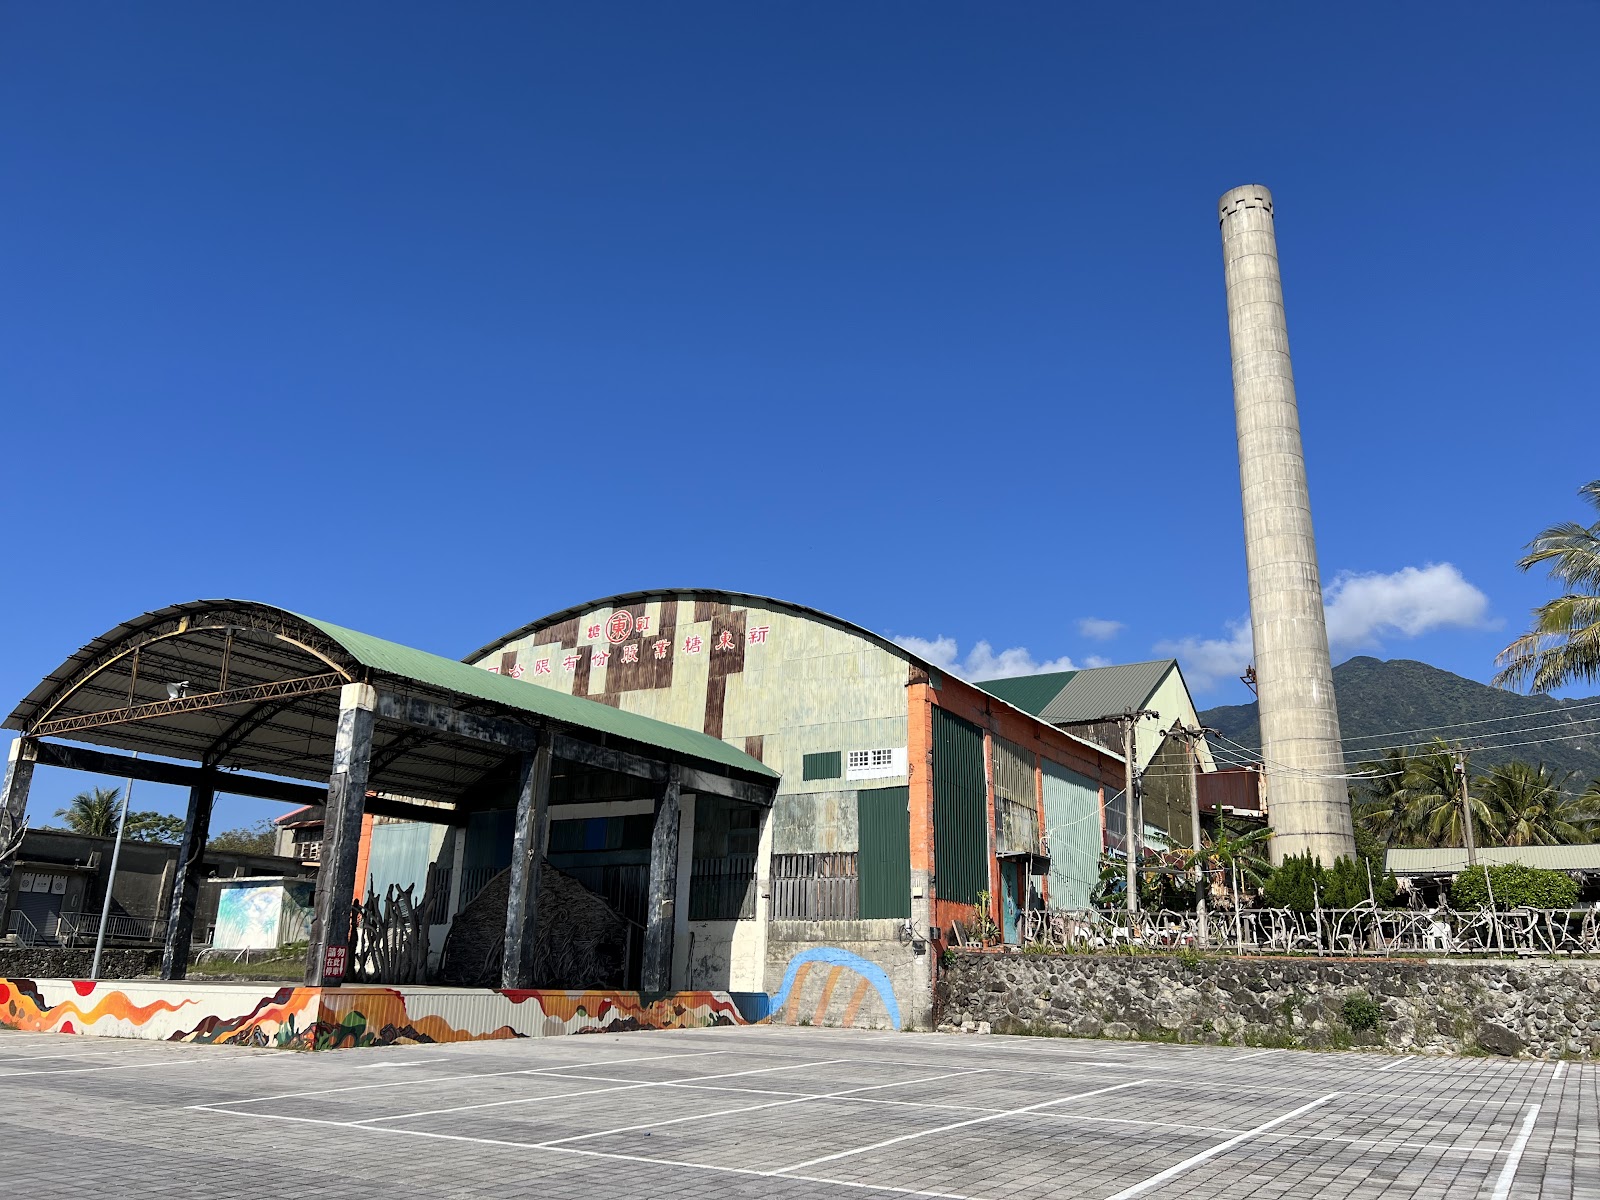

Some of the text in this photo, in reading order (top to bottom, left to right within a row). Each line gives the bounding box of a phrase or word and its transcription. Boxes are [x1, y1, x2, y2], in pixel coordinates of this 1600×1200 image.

[327, 947, 346, 957] 請勿
[326, 957, 341, 967] 在此
[325, 966, 339, 976] 停車
